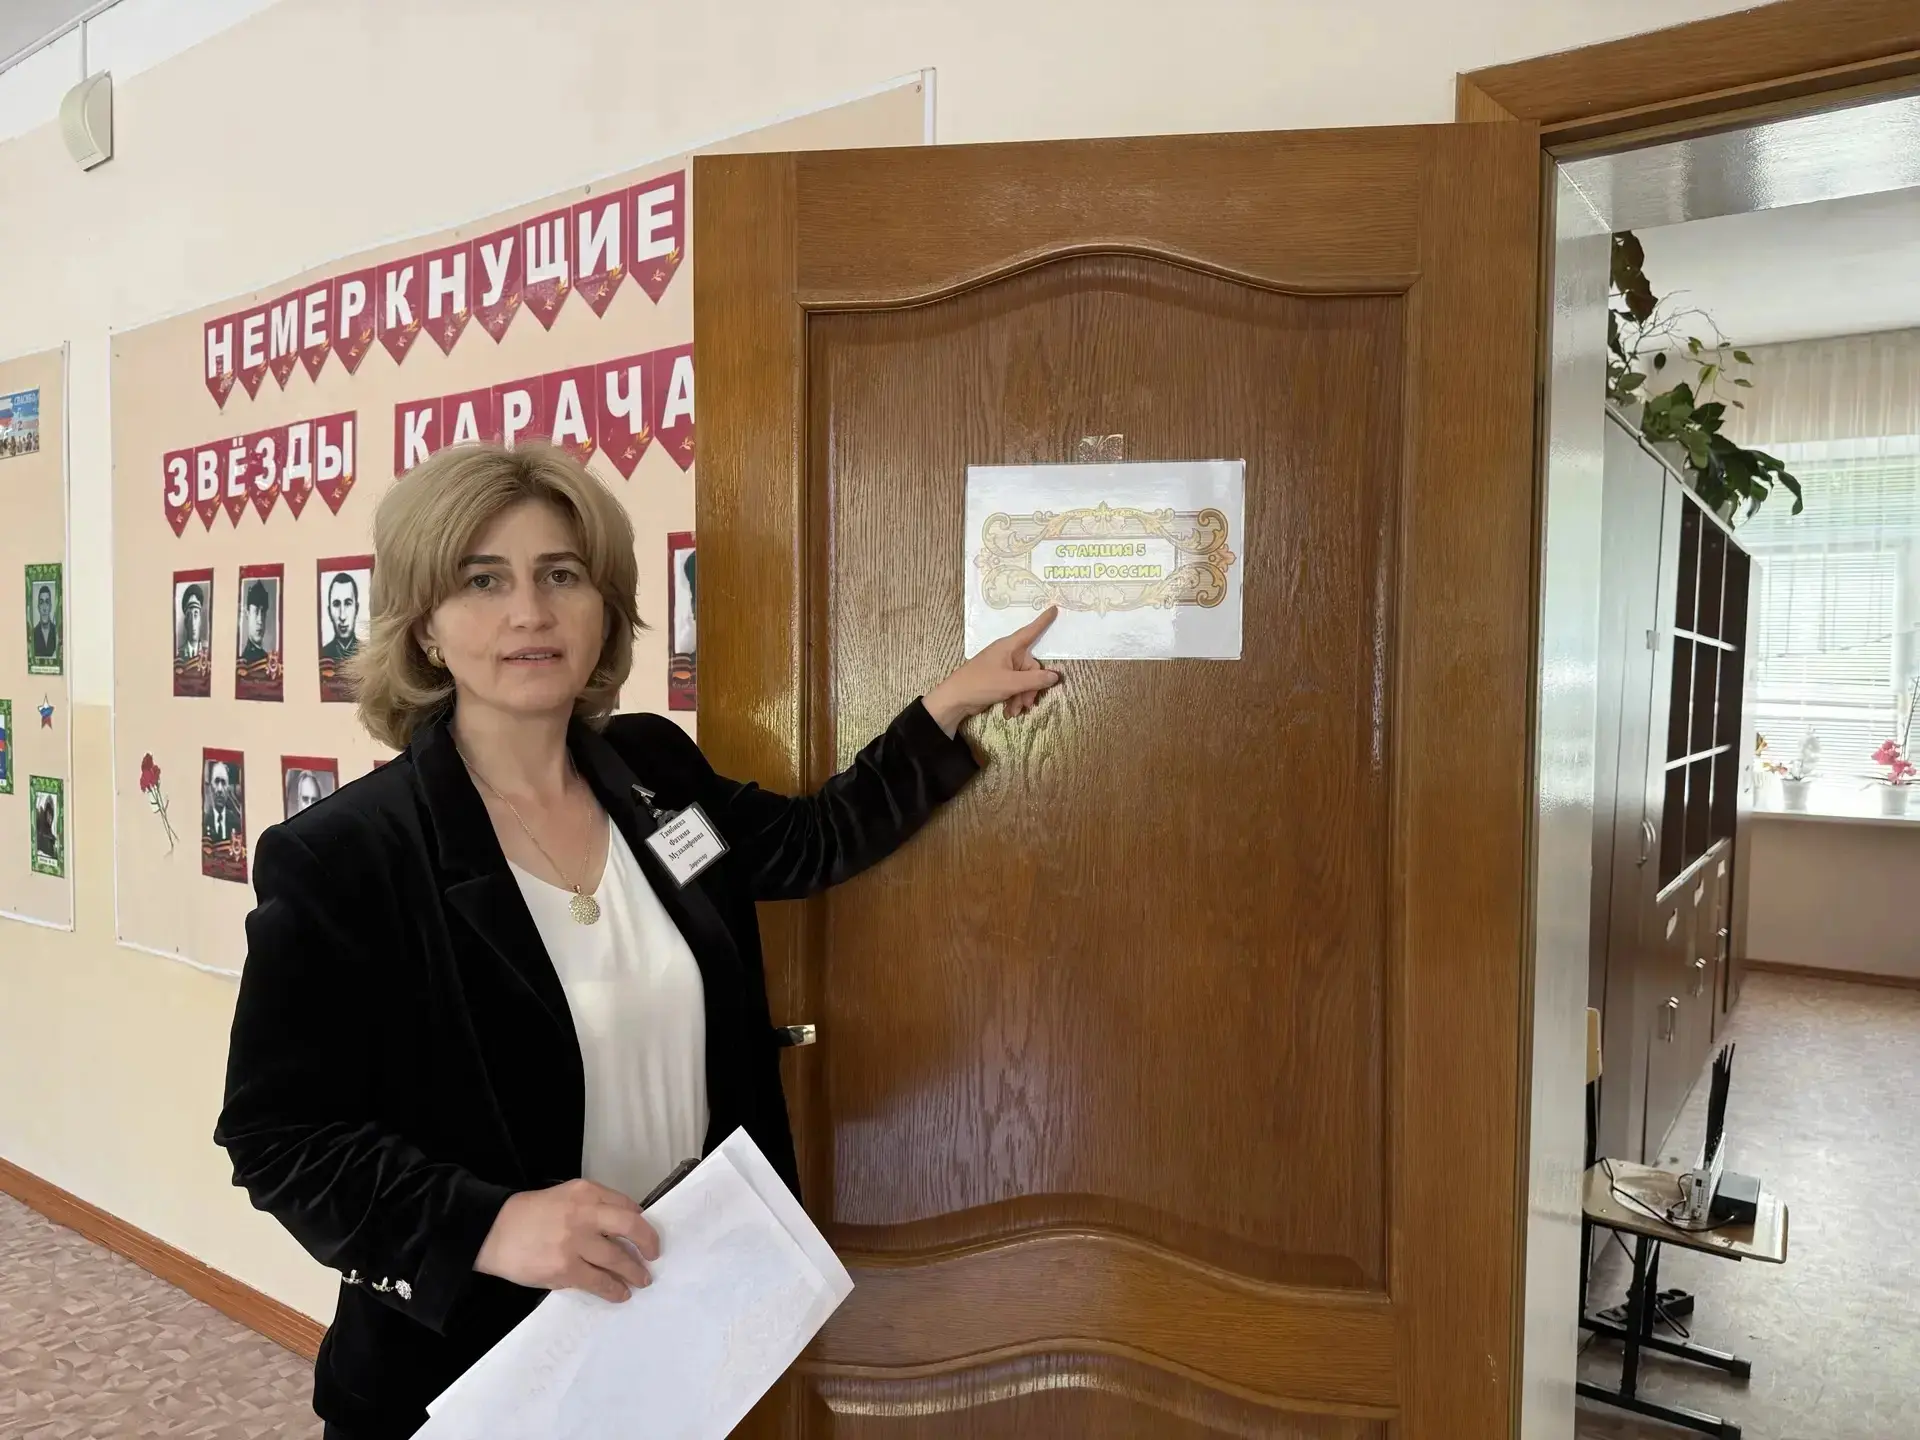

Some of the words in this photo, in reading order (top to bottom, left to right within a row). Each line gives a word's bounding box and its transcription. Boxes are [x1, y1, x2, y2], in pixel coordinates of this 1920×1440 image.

[206, 184, 676, 379] НЕМЕРКНУЩИЕ
[167, 420, 353, 508] ЗВЁЗДЫ
[1056, 543, 1133, 557] СТАНЦИЯ
[1136, 543, 1146, 556] 5
[1044, 565, 1091, 579] ГИМН
[668, 828, 691, 846] Фатима
[689, 853, 708, 871] Директор
